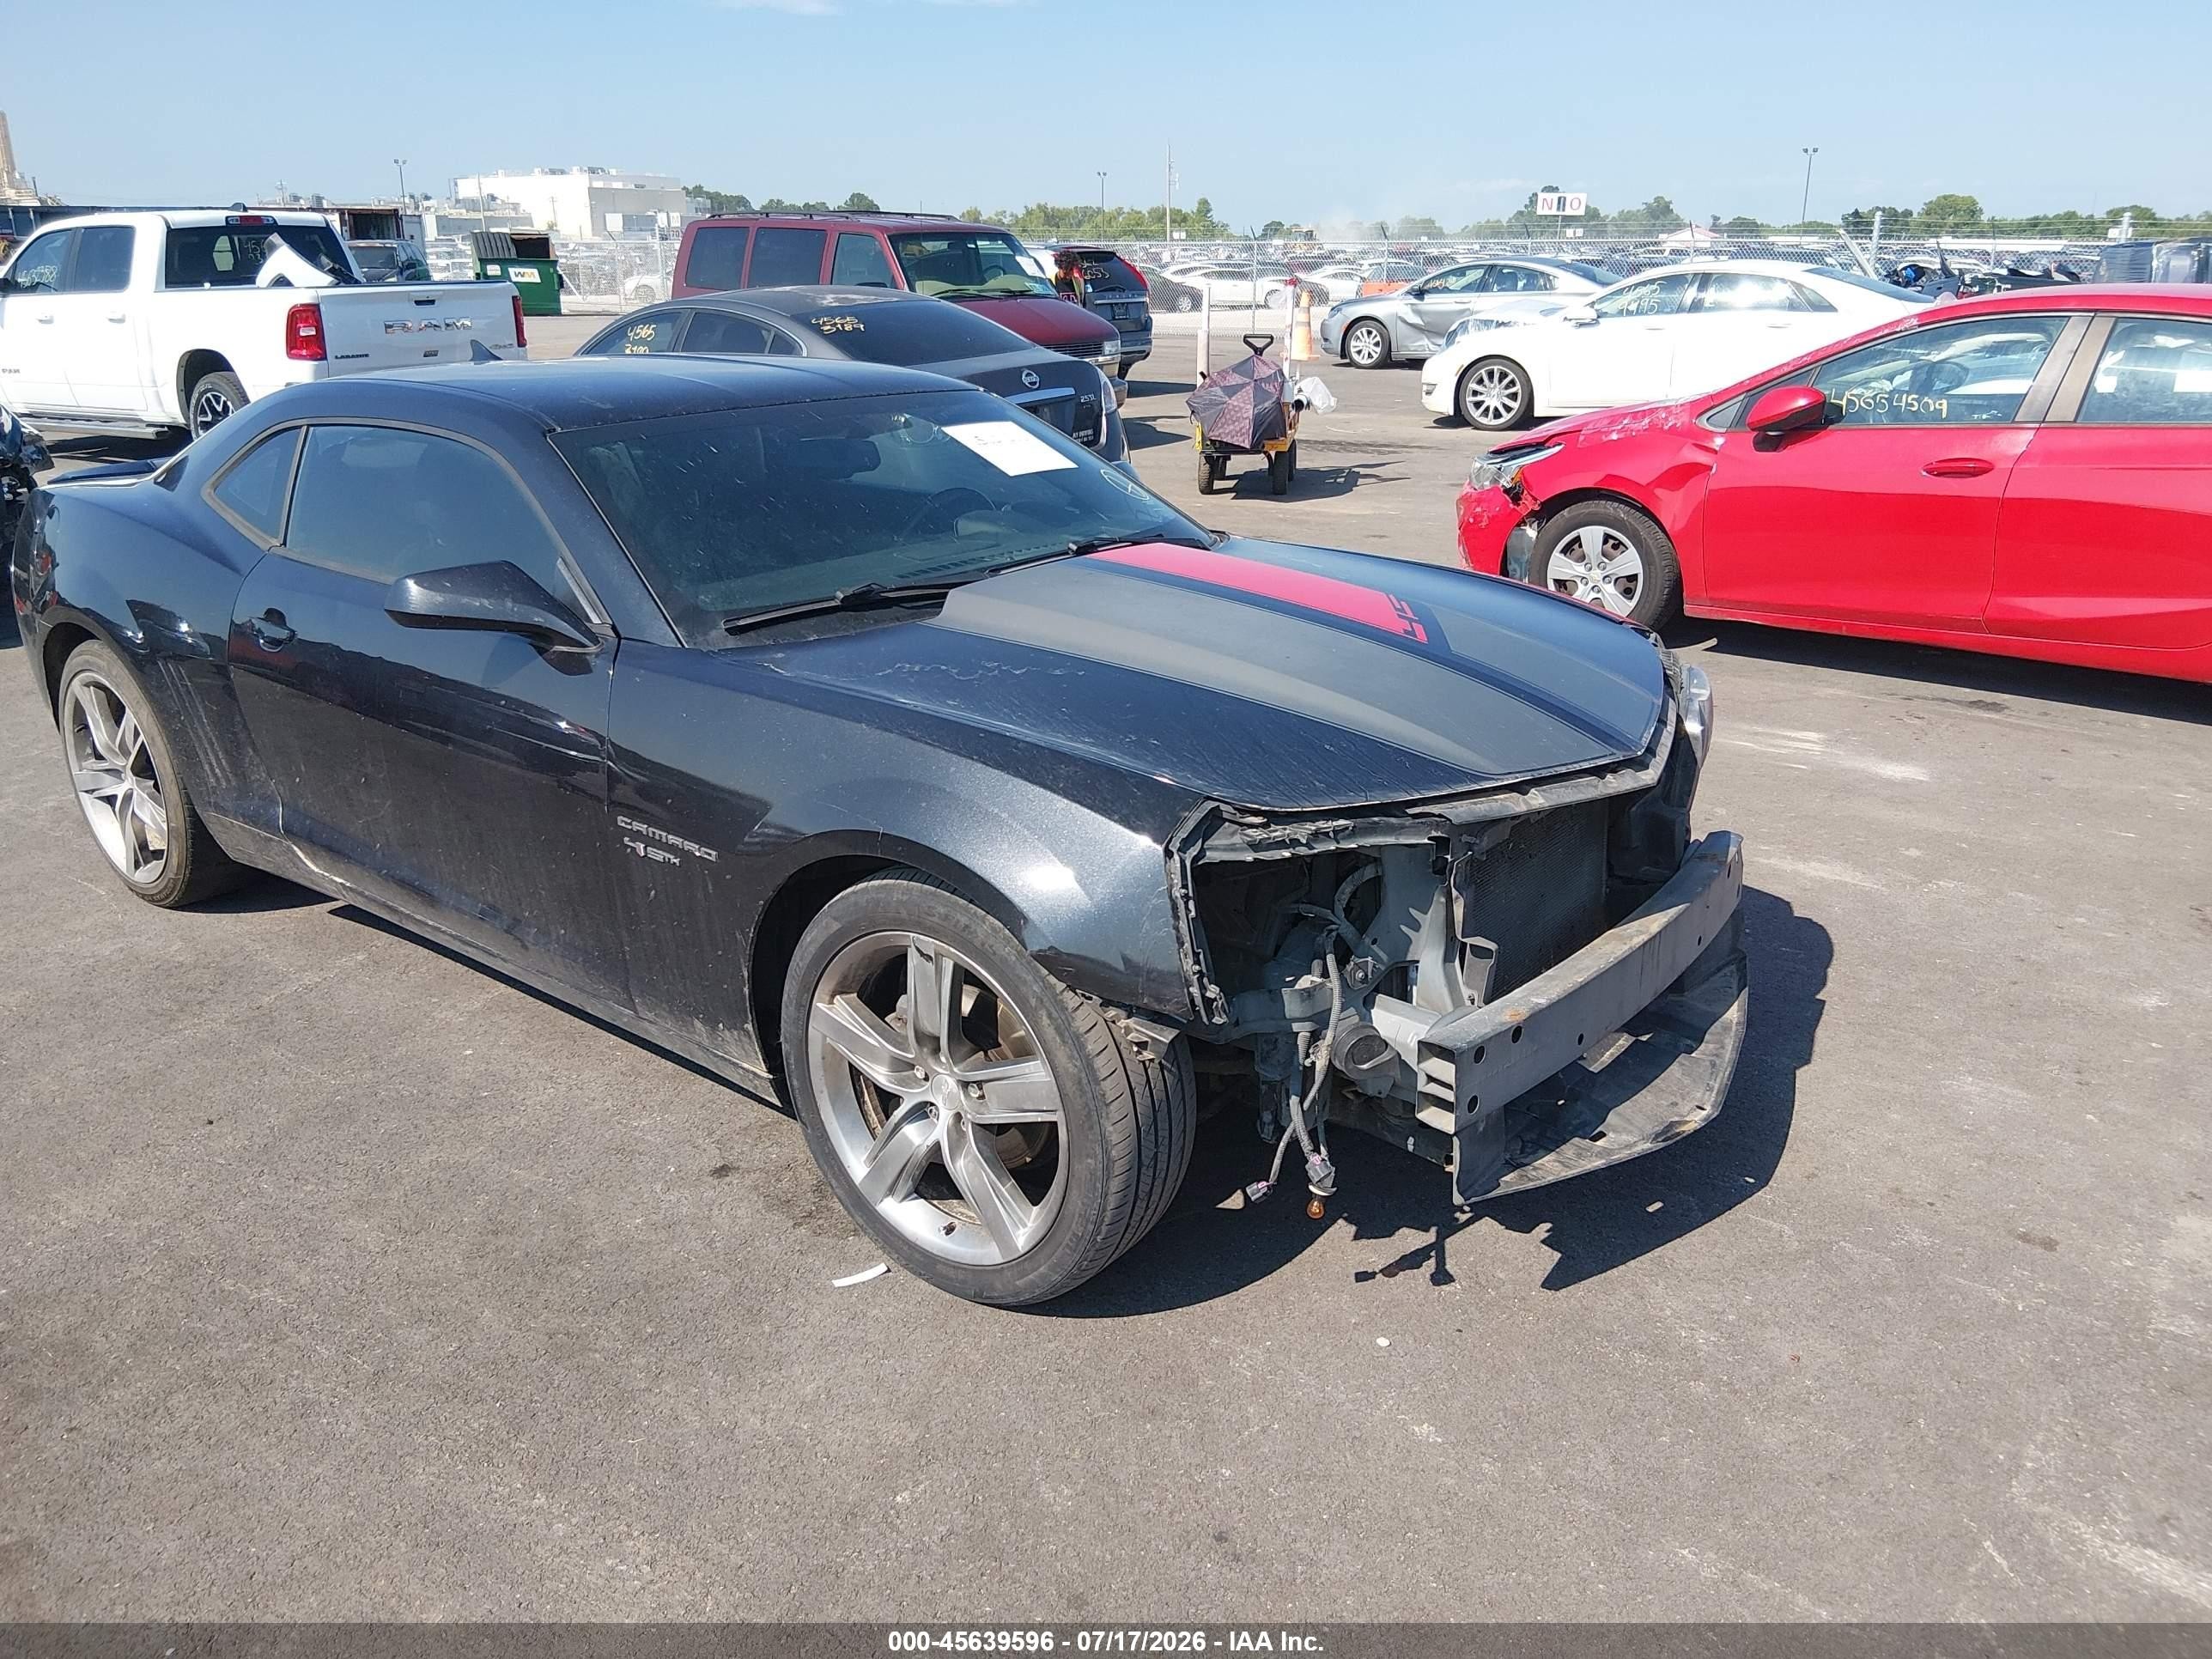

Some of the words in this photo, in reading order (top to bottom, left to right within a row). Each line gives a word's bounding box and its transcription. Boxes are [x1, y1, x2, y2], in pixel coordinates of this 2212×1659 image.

[384, 317, 473, 335] RAM
[811, 316, 859, 325] 4565
[627, 325, 657, 342] 4565
[617, 815, 719, 862] CAMARO
